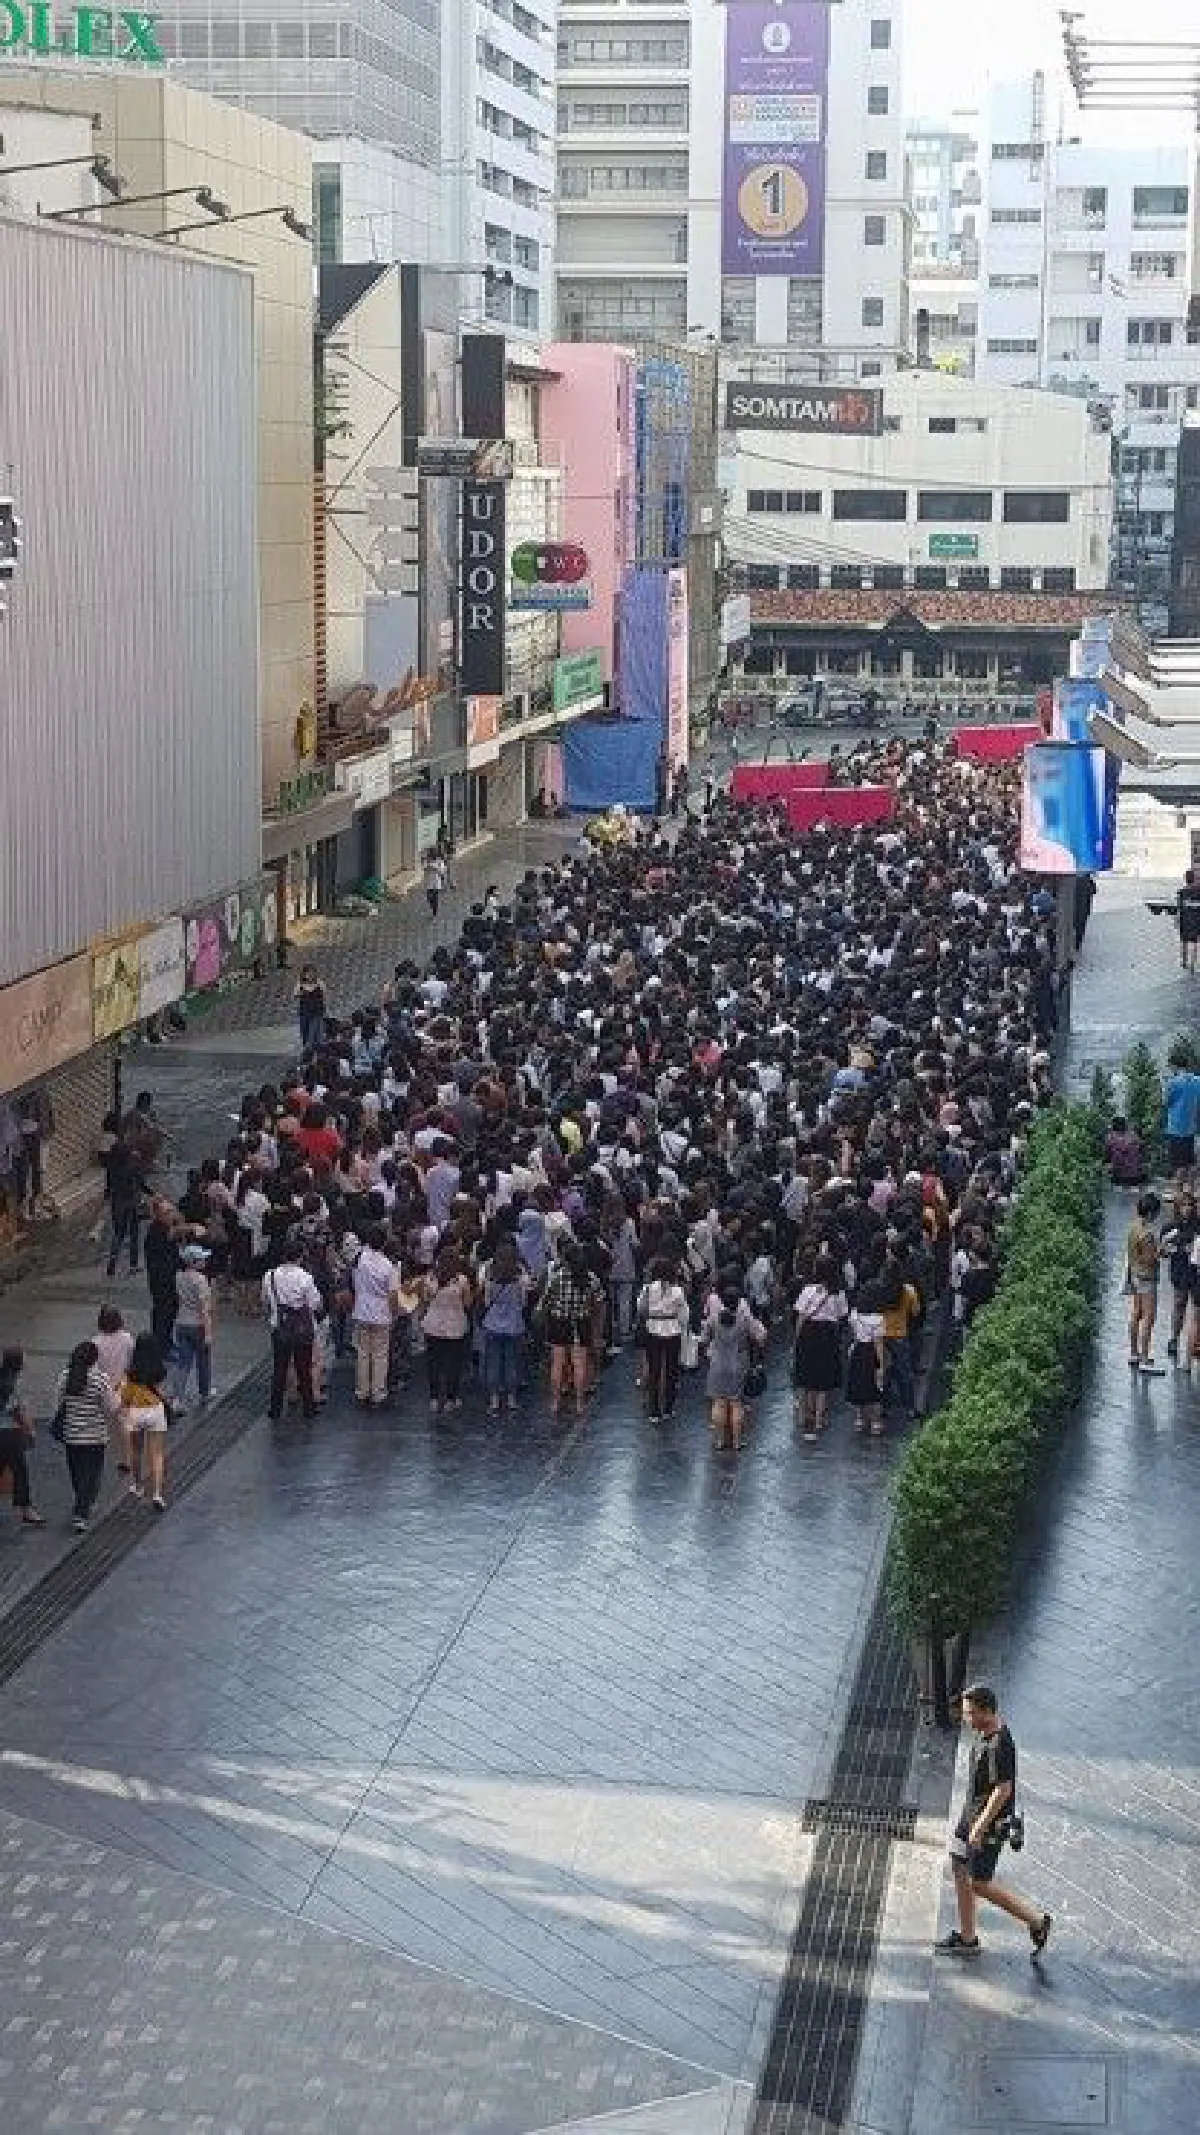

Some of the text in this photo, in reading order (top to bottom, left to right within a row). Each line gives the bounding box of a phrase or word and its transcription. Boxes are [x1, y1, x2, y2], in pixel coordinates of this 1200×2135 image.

[762, 172, 786, 216] 1
[732, 396, 838, 422] SOMTAM
[469, 479, 495, 630] UDOR
